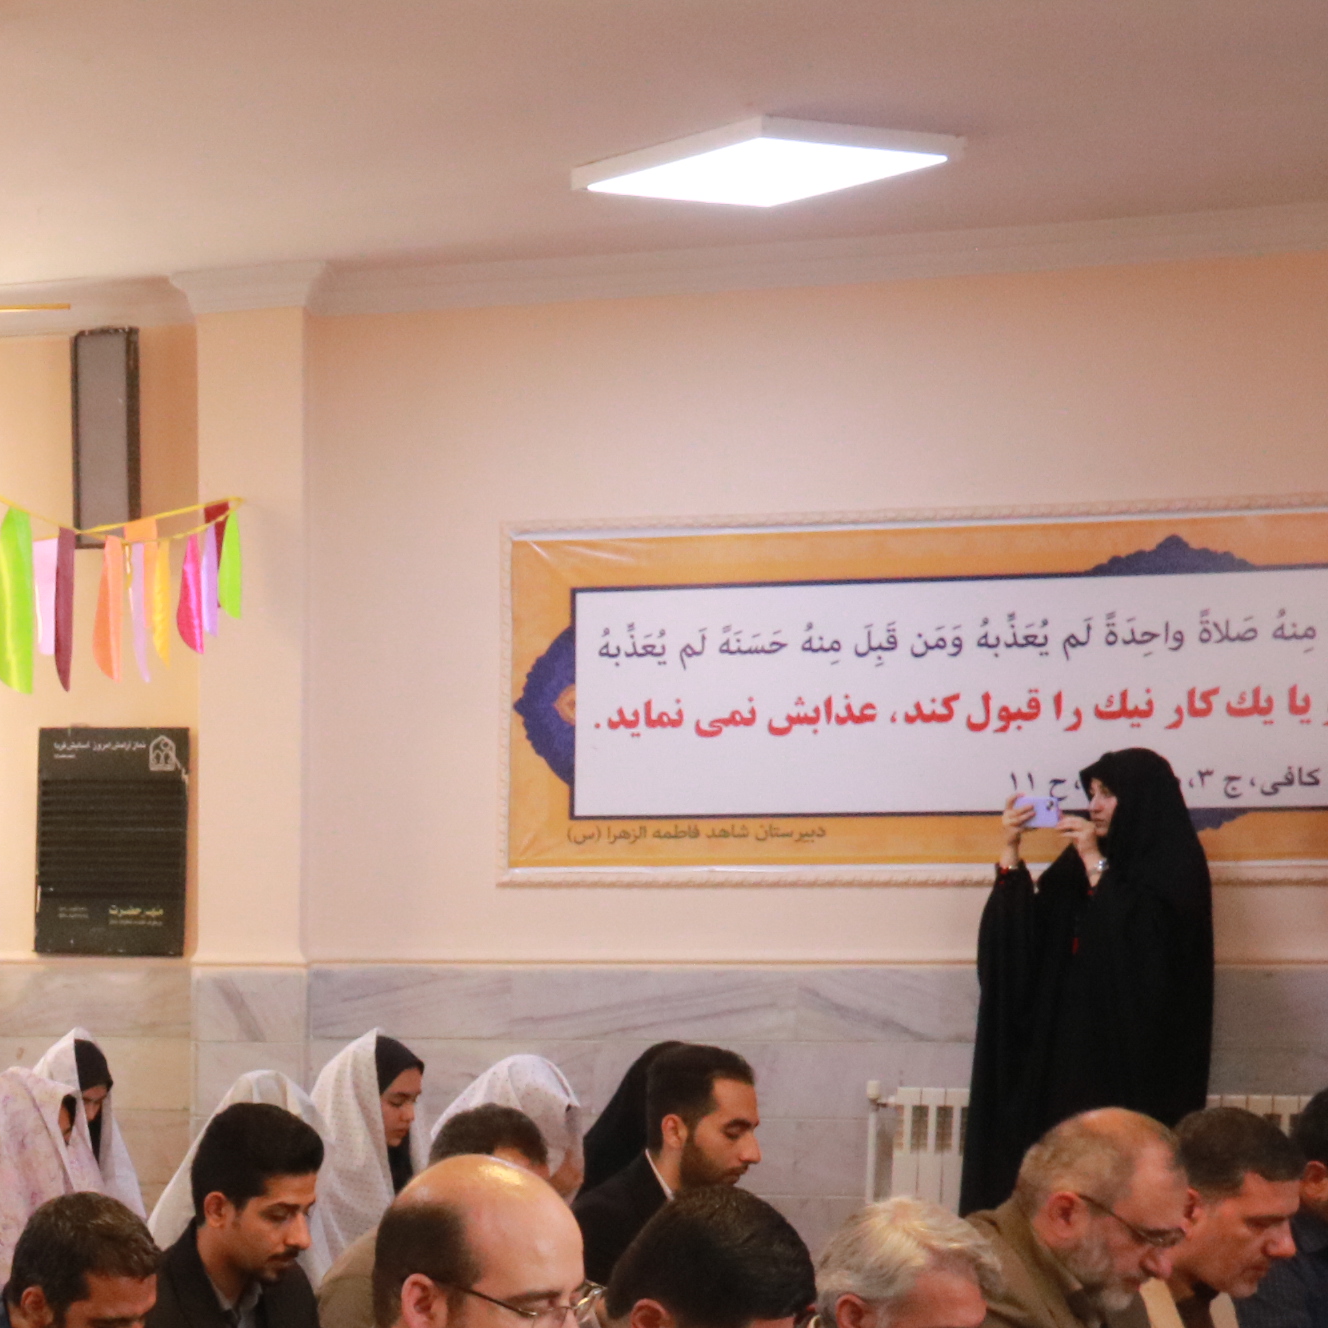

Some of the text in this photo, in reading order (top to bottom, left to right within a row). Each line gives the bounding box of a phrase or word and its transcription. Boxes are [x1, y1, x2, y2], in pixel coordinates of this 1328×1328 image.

[767, 693, 877, 736] عذابش
[966, 688, 1042, 733] قبول
[1053, 690, 1083, 731] را
[1224, 774, 1243, 799] ج
[652, 824, 700, 840] فاطمه
[706, 824, 749, 840] شاهد
